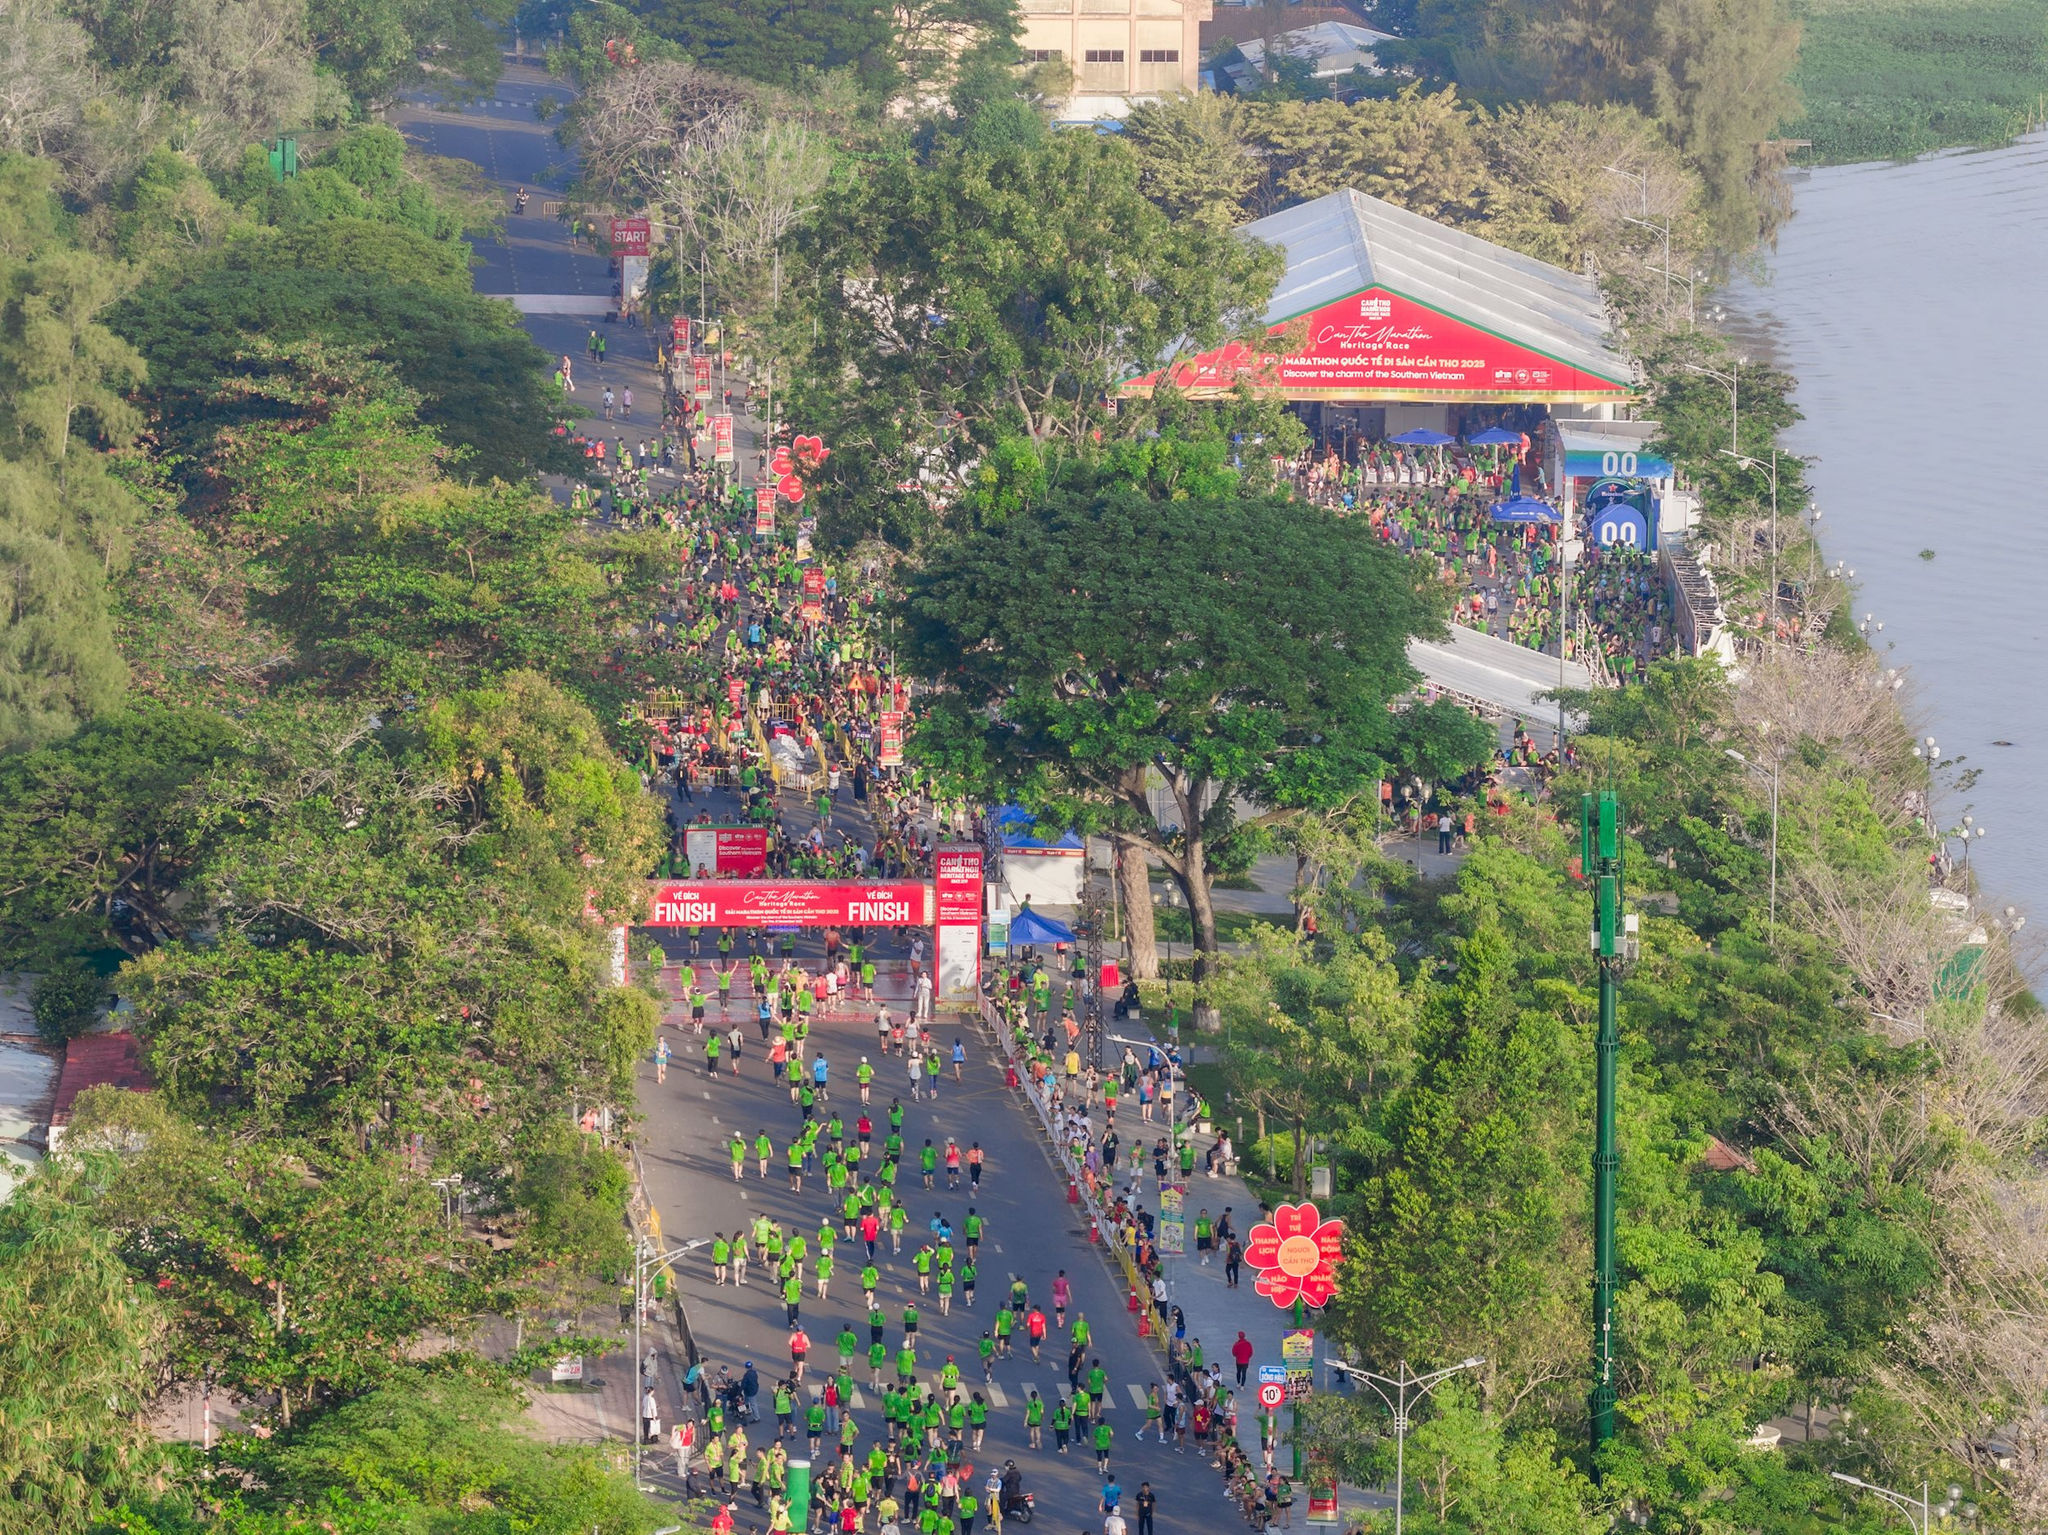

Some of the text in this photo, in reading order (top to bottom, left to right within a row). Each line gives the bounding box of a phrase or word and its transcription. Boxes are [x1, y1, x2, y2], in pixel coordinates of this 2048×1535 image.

[614, 231, 646, 242] START
[1340, 341, 1410, 350] Heritage Race
[1285, 358, 1337, 366] MARATHON
[1340, 354, 1369, 367] QUỐC
[1370, 354, 1382, 366] TẾ
[1384, 358, 1394, 366] DI
[1461, 359, 1486, 368] 2025
[1283, 370, 1464, 380] Discover the charm of the Southern Vietnam
[654, 902, 716, 922] FINISH
[848, 902, 909, 922] FINISH
